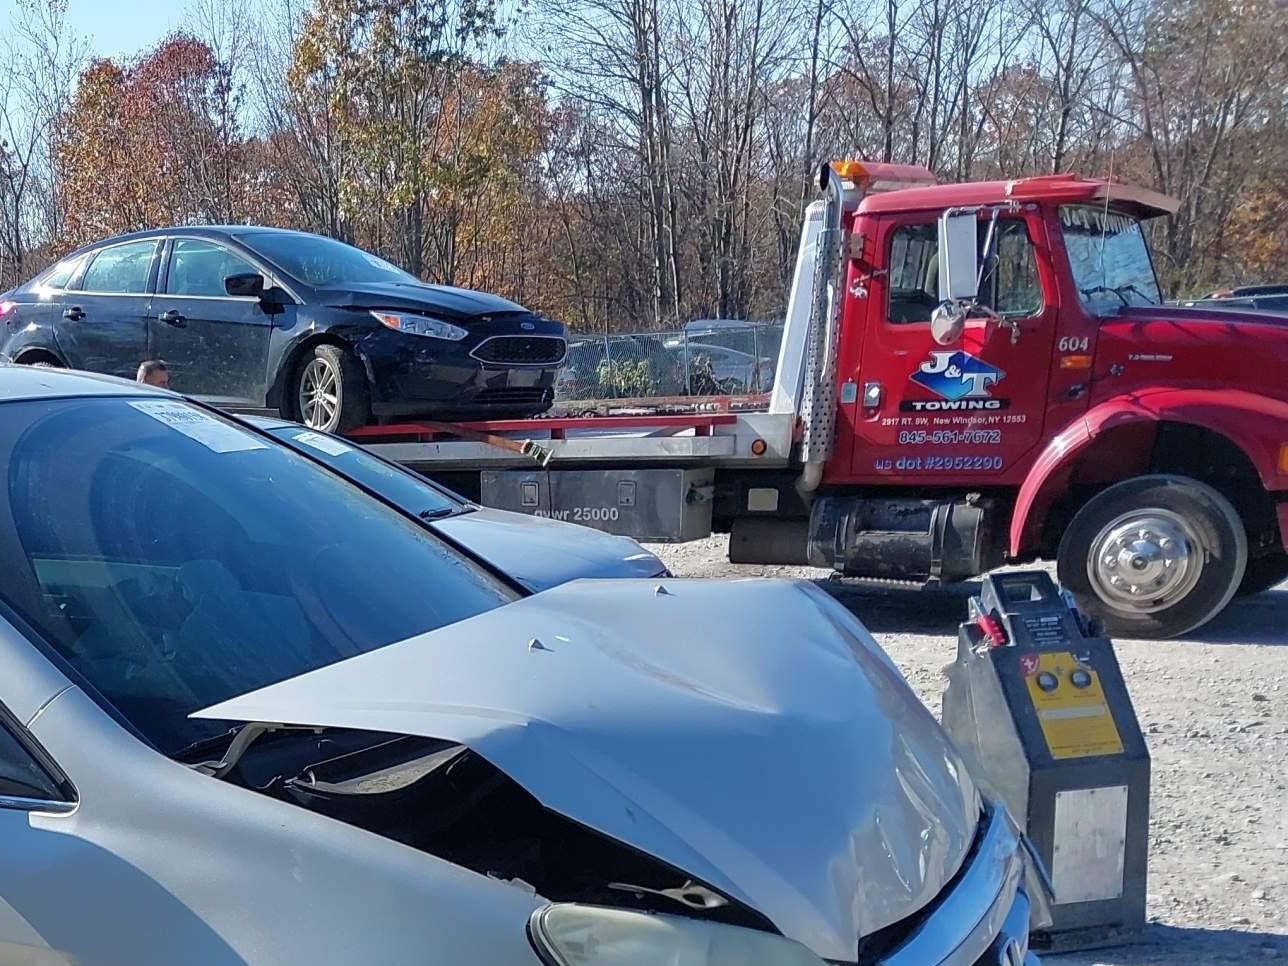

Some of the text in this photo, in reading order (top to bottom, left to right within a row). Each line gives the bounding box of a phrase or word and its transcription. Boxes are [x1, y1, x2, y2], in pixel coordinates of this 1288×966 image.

[1059, 336, 1089, 351] 604
[920, 350, 999, 397] J&T
[911, 400, 1000, 410] TOWING
[933, 417, 951, 425] New
[896, 456, 921, 470] dot
[924, 455, 1003, 470] #2952290
[573, 507, 619, 521] 25000
